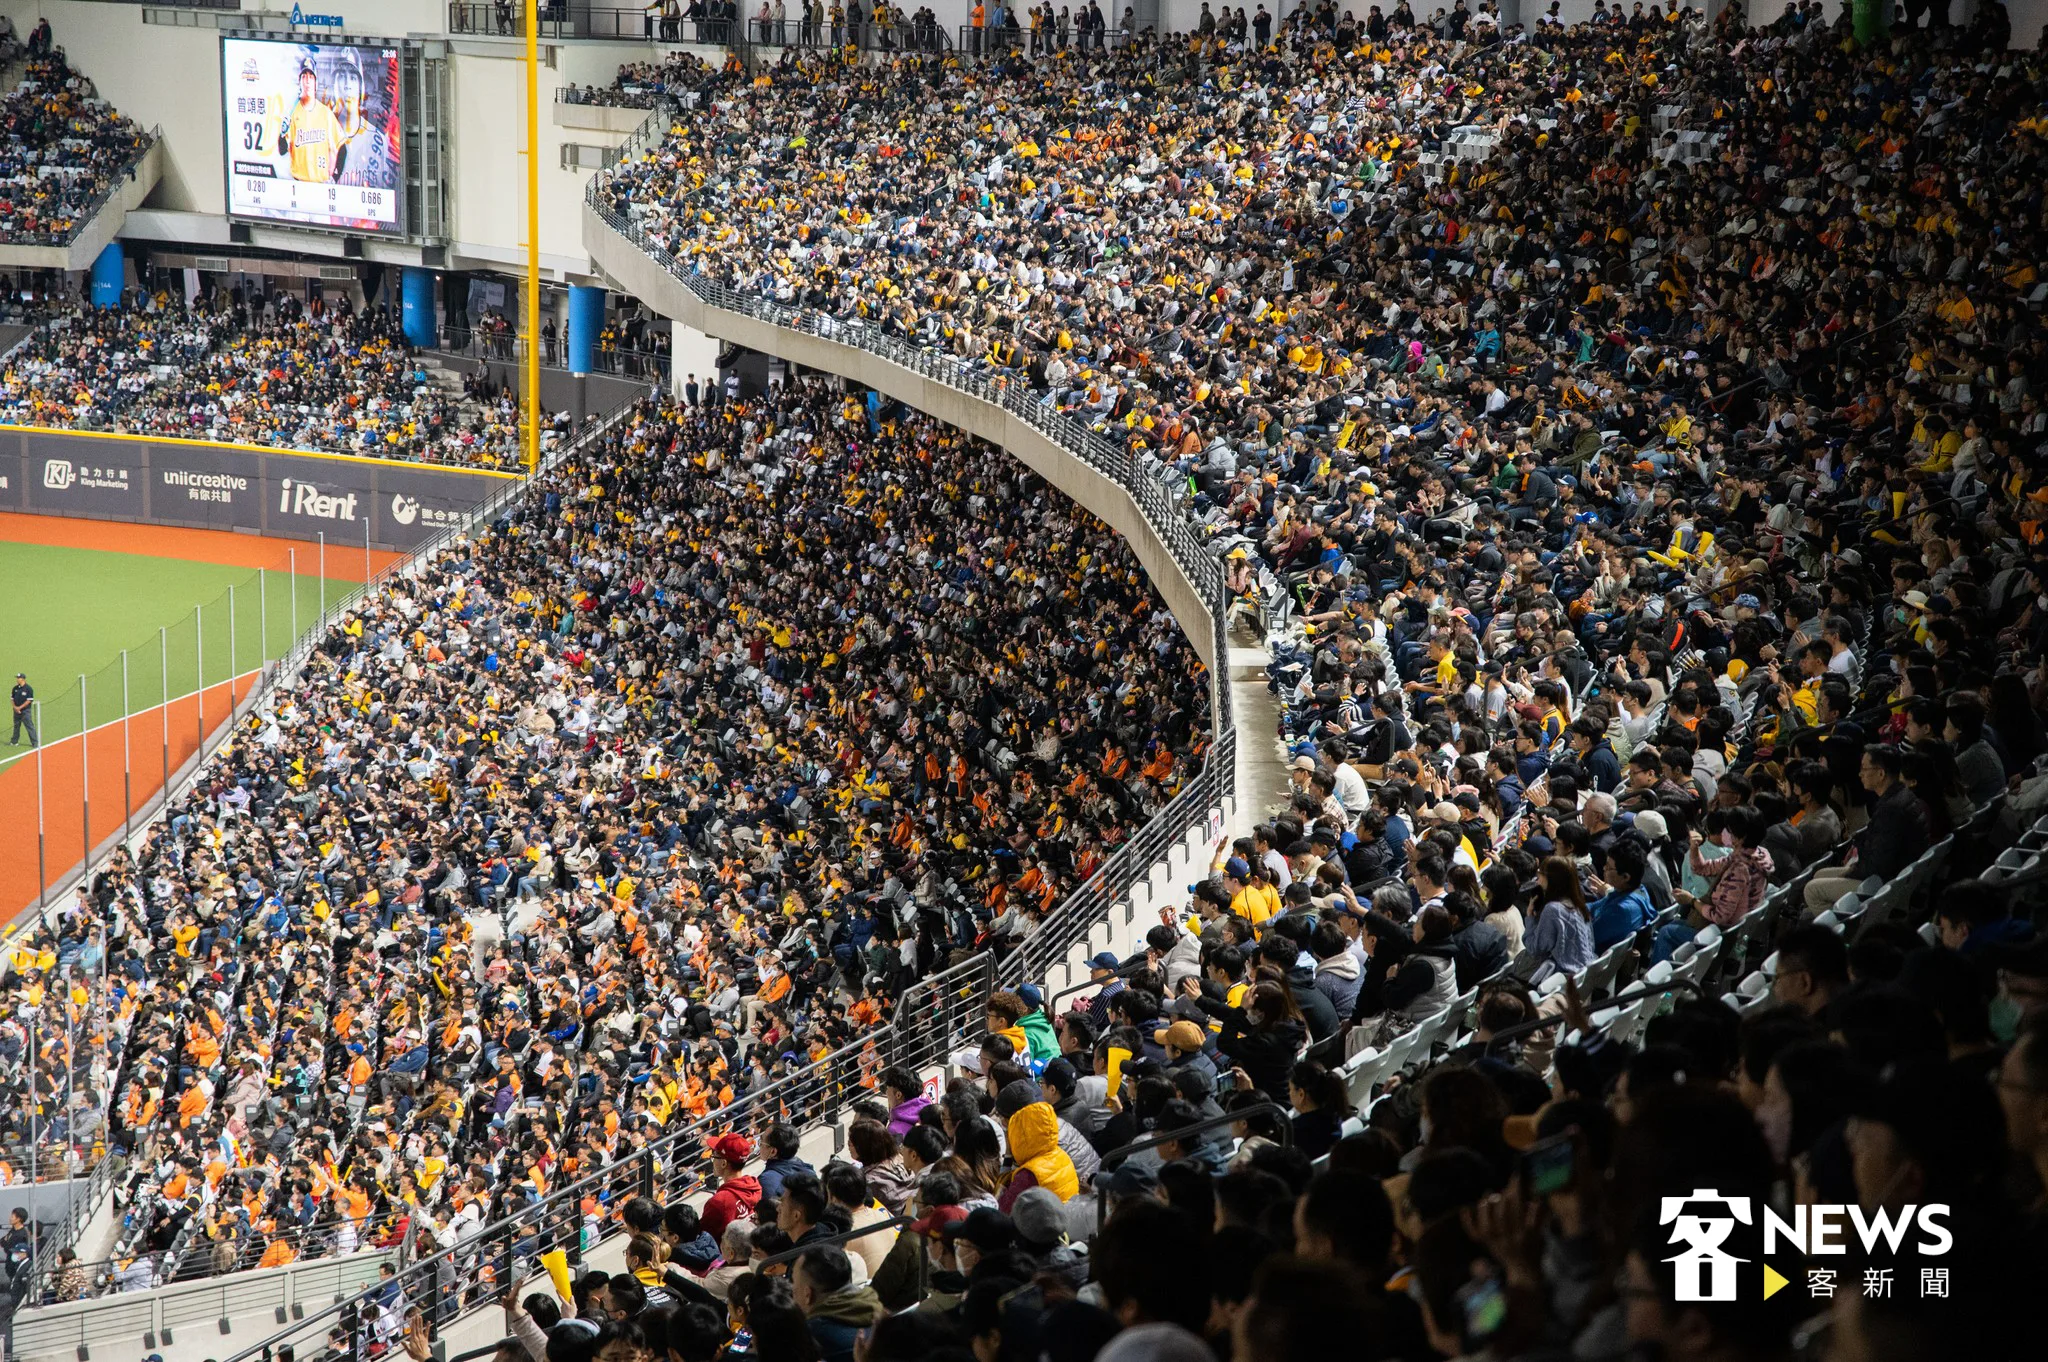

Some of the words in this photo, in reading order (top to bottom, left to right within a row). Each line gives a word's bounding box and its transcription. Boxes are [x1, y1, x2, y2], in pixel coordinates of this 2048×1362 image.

[244, 121, 263, 151] 32
[247, 180, 266, 193] 0.280
[292, 185, 296, 196] 1
[328, 188, 336, 200] 19
[361, 191, 382, 205] 0.686
[80, 477, 96, 488] King
[96, 479, 129, 490] Marketing
[163, 470, 248, 491] uniicreative
